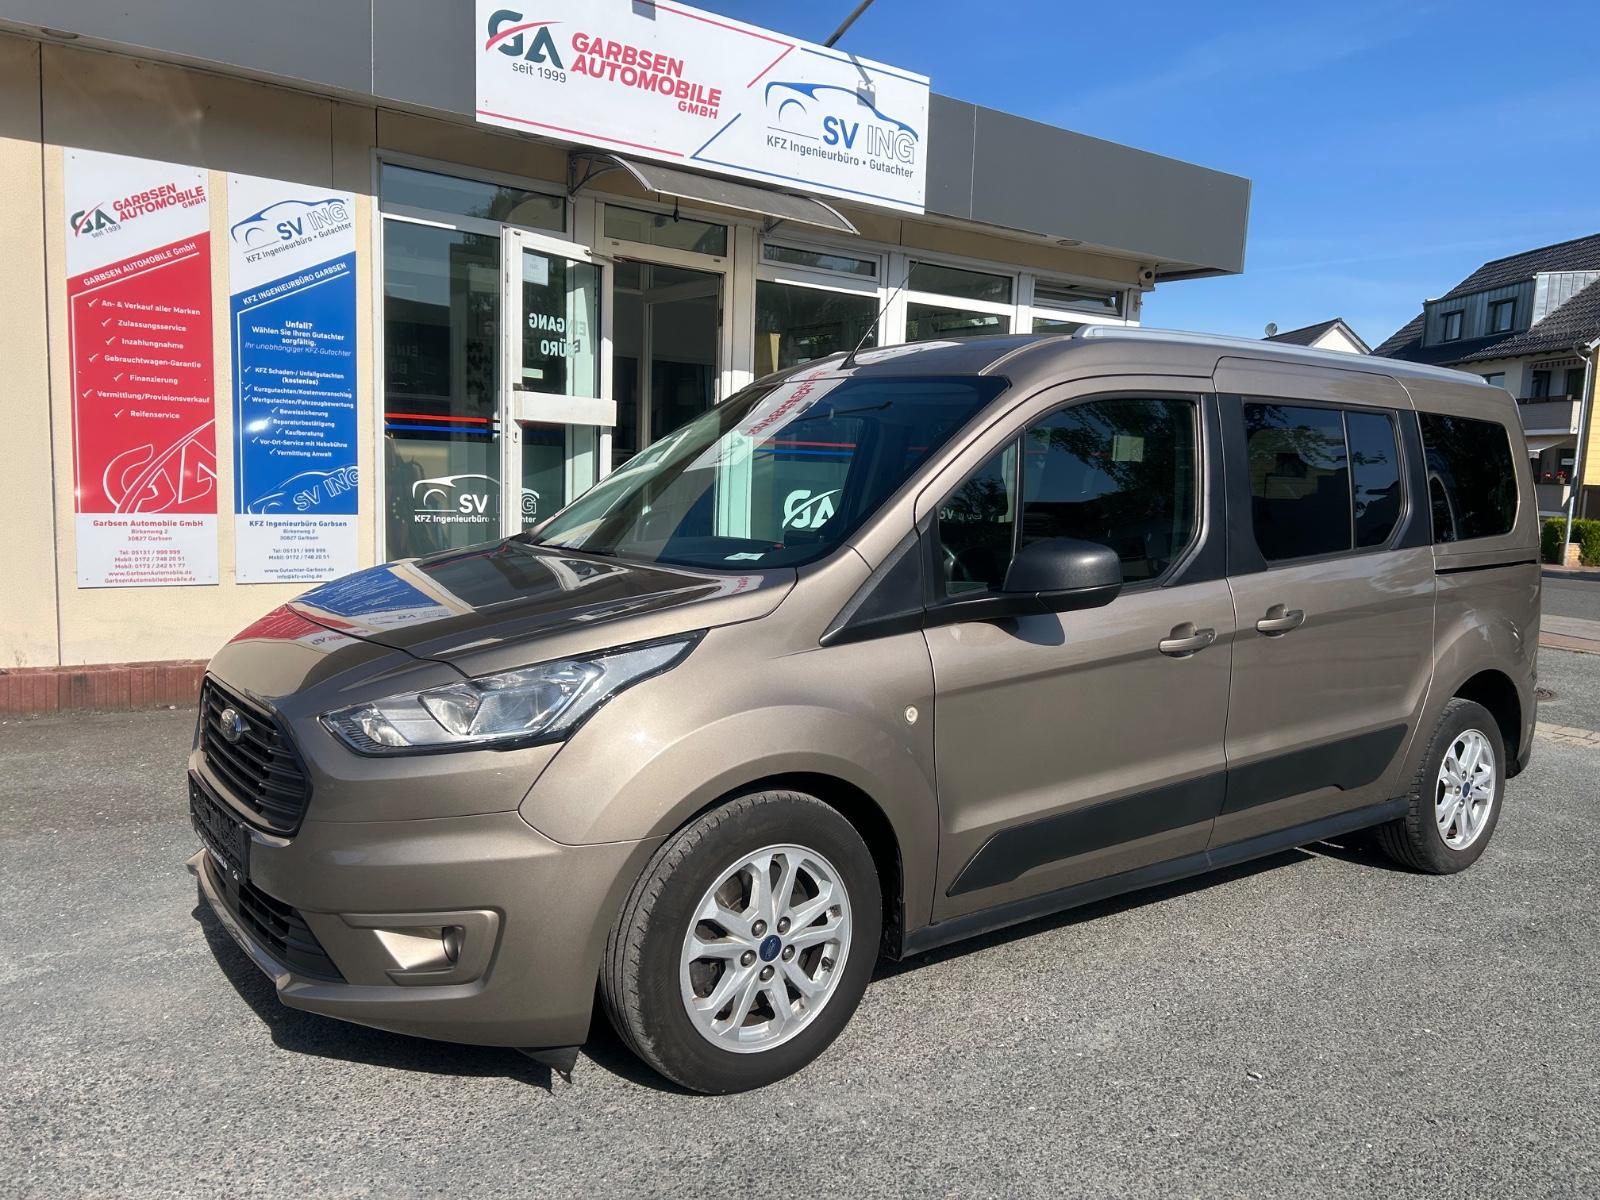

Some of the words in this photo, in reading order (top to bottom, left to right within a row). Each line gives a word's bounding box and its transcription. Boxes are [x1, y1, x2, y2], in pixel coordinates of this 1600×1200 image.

[571, 32, 684, 78] GARBSEN
[512, 62, 533, 76] seit
[537, 67, 567, 83] 1999
[570, 54, 722, 107] AUTOMOBILE
[677, 100, 718, 119] GMBH
[822, 115, 860, 149] SV
[867, 124, 915, 165] ING
[767, 135, 787, 150] KFZ
[790, 140, 860, 166] Ingenieurbüro
[869, 159, 914, 179] Gutachter
[113, 183, 177, 211] GARBSEN
[119, 186, 205, 222] AUTOMOBILE
[181, 196, 207, 209] GMBH
[276, 217, 304, 241] SV
[307, 202, 349, 230] ING
[91, 230, 104, 239] seit
[105, 224, 121, 234] 1999
[245, 253, 262, 264] KFZ
[262, 235, 313, 258] Ingenieurbüro
[318, 222, 352, 238] Gutachter
[83, 268, 122, 286] GARBSEN
[122, 250, 171, 274] AUTOMOBILE
[172, 243, 197, 256] GmbH
[242, 295, 258, 305] KFZ
[258, 275, 314, 299] INGENIEURBÜRO
[314, 262, 347, 279] GARBSEN
[102, 300, 115, 308] An-
[124, 302, 154, 311] Verkauf
[155, 305, 171, 313] aller
[173, 306, 201, 315] Marken
[117, 319, 187, 332] Zulassungsservice
[252, 326, 279, 334] Wählen
[292, 330, 311, 338] Ihren
[312, 332, 344, 341] Gutachter
[285, 320, 313, 330] Unfall?
[121, 338, 184, 350] Inzahlungnahme
[104, 355, 201, 368] Gebrauchtwagen-Garantie
[129, 374, 178, 385] Finanzierung
[97, 391, 210, 403] Vermittlung/Provisionsverkauf
[130, 410, 180, 419] Reifenservice
[293, 485, 321, 511] SV
[459, 493, 488, 513] SV
[266, 520, 317, 528] Ingenieurbüro
[414, 514, 431, 523] KFZ
[433, 514, 490, 524] Ingenieurbüro
